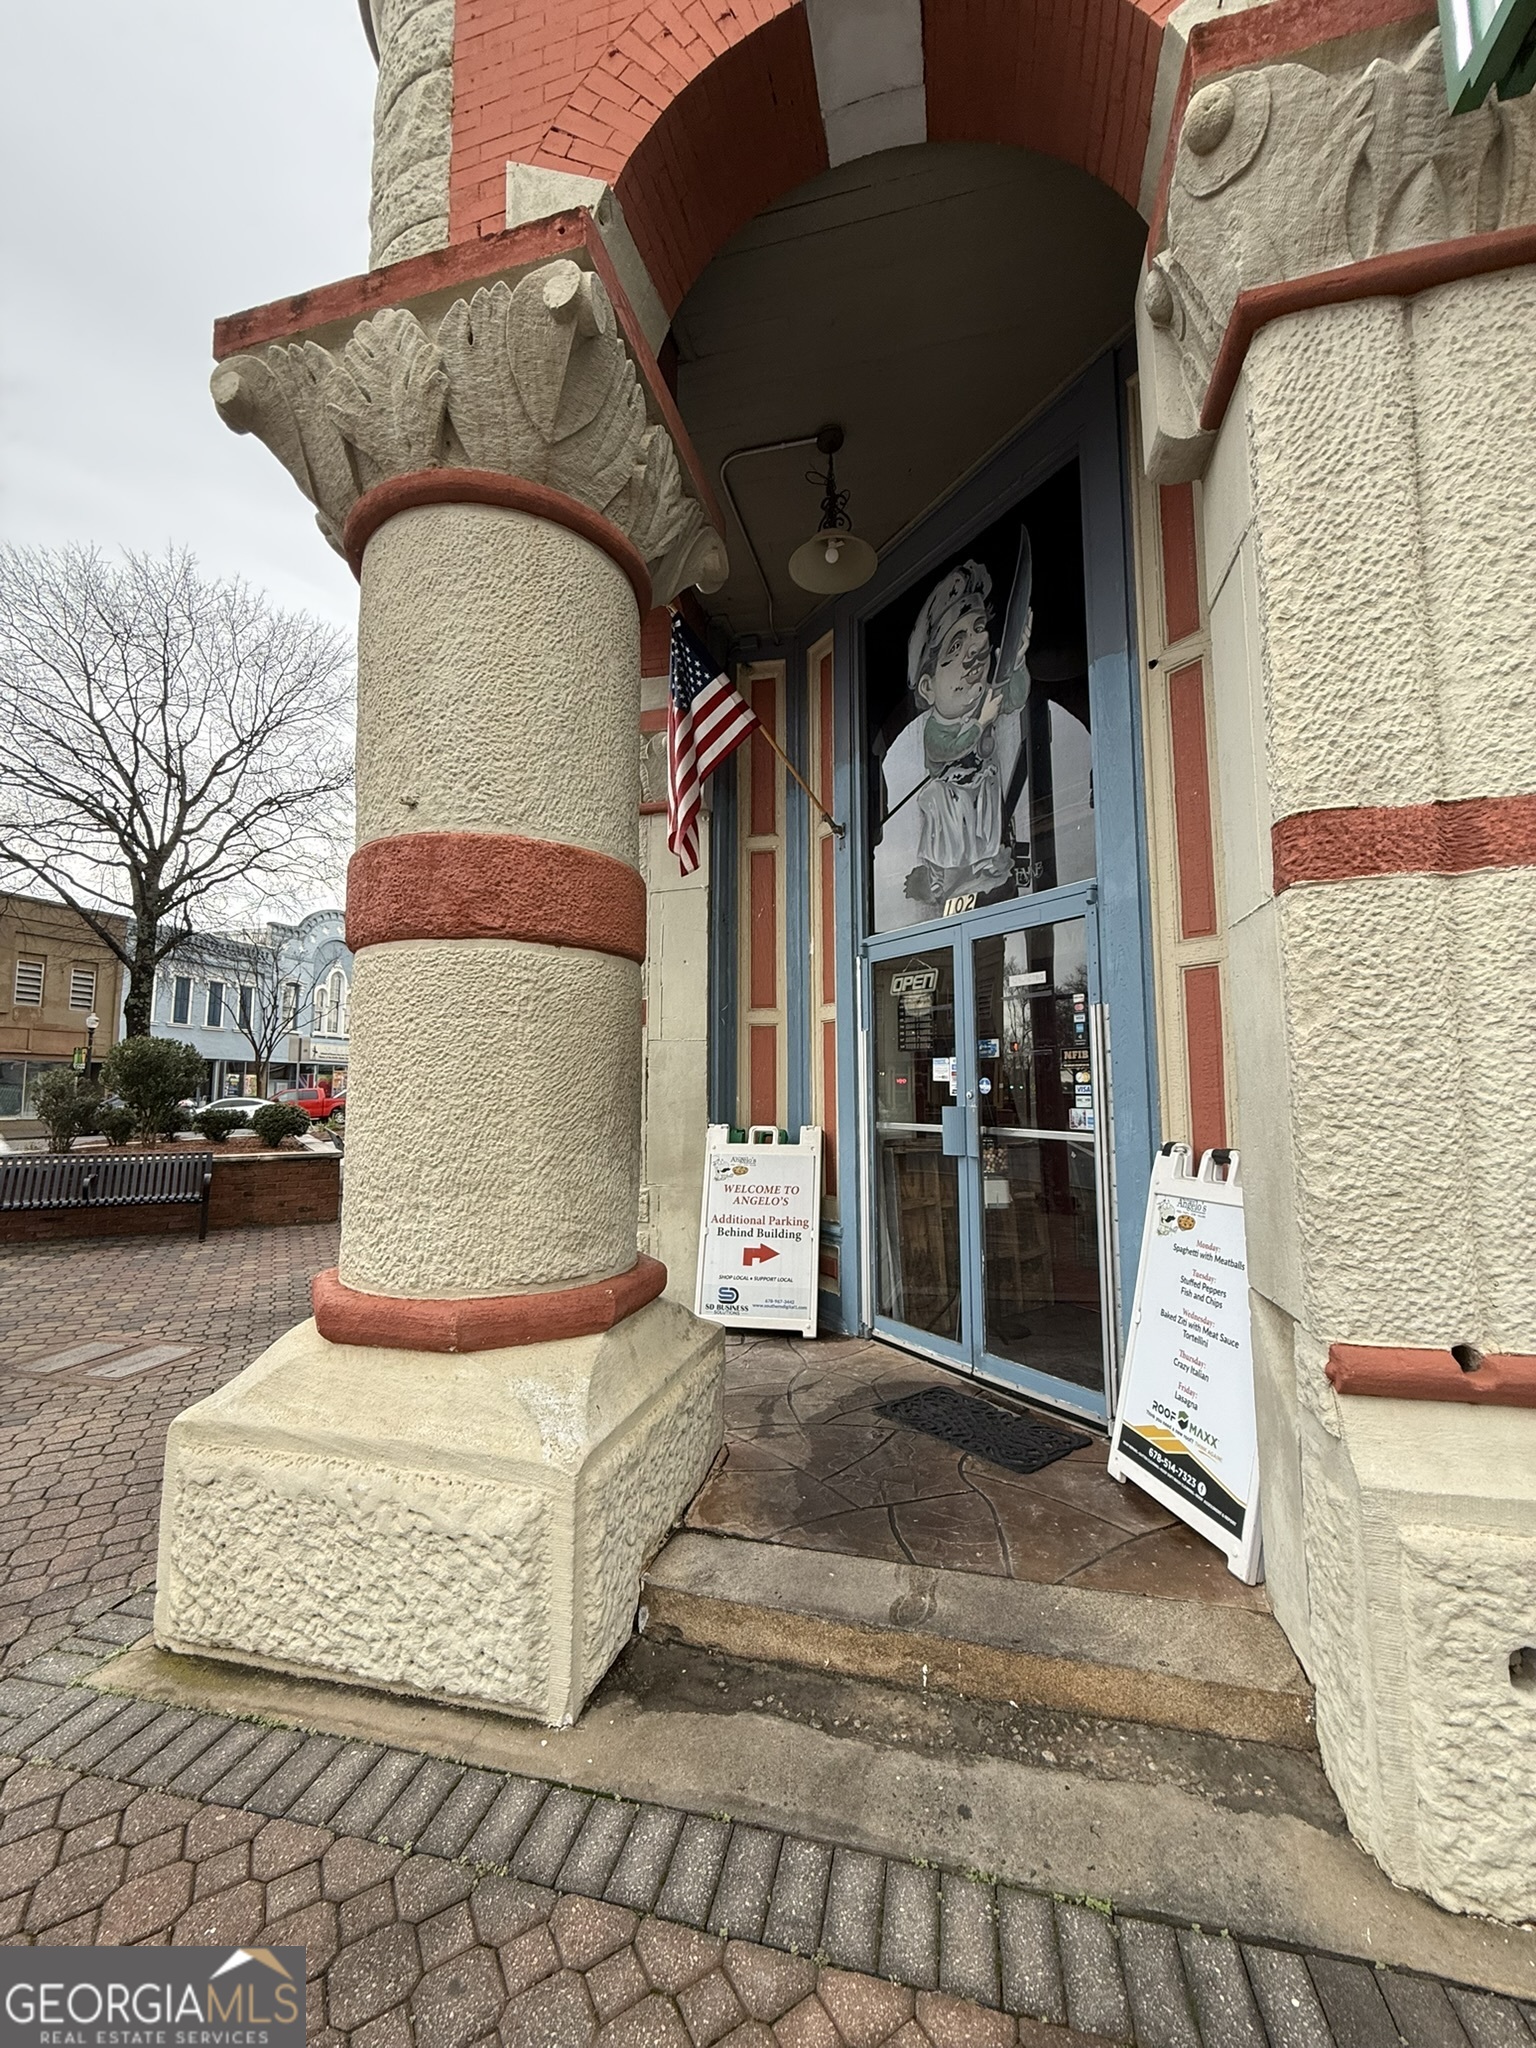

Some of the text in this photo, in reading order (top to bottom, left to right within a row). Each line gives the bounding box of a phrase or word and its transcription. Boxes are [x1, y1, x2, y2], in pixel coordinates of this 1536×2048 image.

[946, 893, 975, 916] 102
[892, 972, 935, 993] OPEN
[1063, 1050, 1089, 1060] NFIB
[724, 1184, 800, 1195] WELCOME TO
[732, 1196, 790, 1206] ANGELO'S
[1176, 1197, 1207, 1212] Angelo's
[711, 1214, 810, 1230] Additional Parking
[717, 1227, 802, 1242] Behind Building
[1196, 1239, 1221, 1253] Monday:
[1173, 1243, 1246, 1271] Spaghetti with Meatballs
[1180, 1275, 1227, 1298] Stuffed Peppers
[1192, 1268, 1217, 1284] Tuesday:
[716, 1304, 749, 1312] BUSINESS
[1180, 1286, 1223, 1309] Fish and Chips
[1182, 1307, 1216, 1328] Wednesday:
[1160, 1308, 1240, 1349] Baked Ziti with Meat Sauce
[1182, 1329, 1209, 1348] Tortellini
[1179, 1348, 1207, 1369] Thursday:
[1173, 1357, 1210, 1382] Crazy Italian
[1174, 1390, 1198, 1411] Lasagna
[1177, 1381, 1198, 1400] Friday:
[1152, 1400, 1219, 1449] ROOF MAXX
[1148, 1447, 1197, 1488] 678-514-7323
